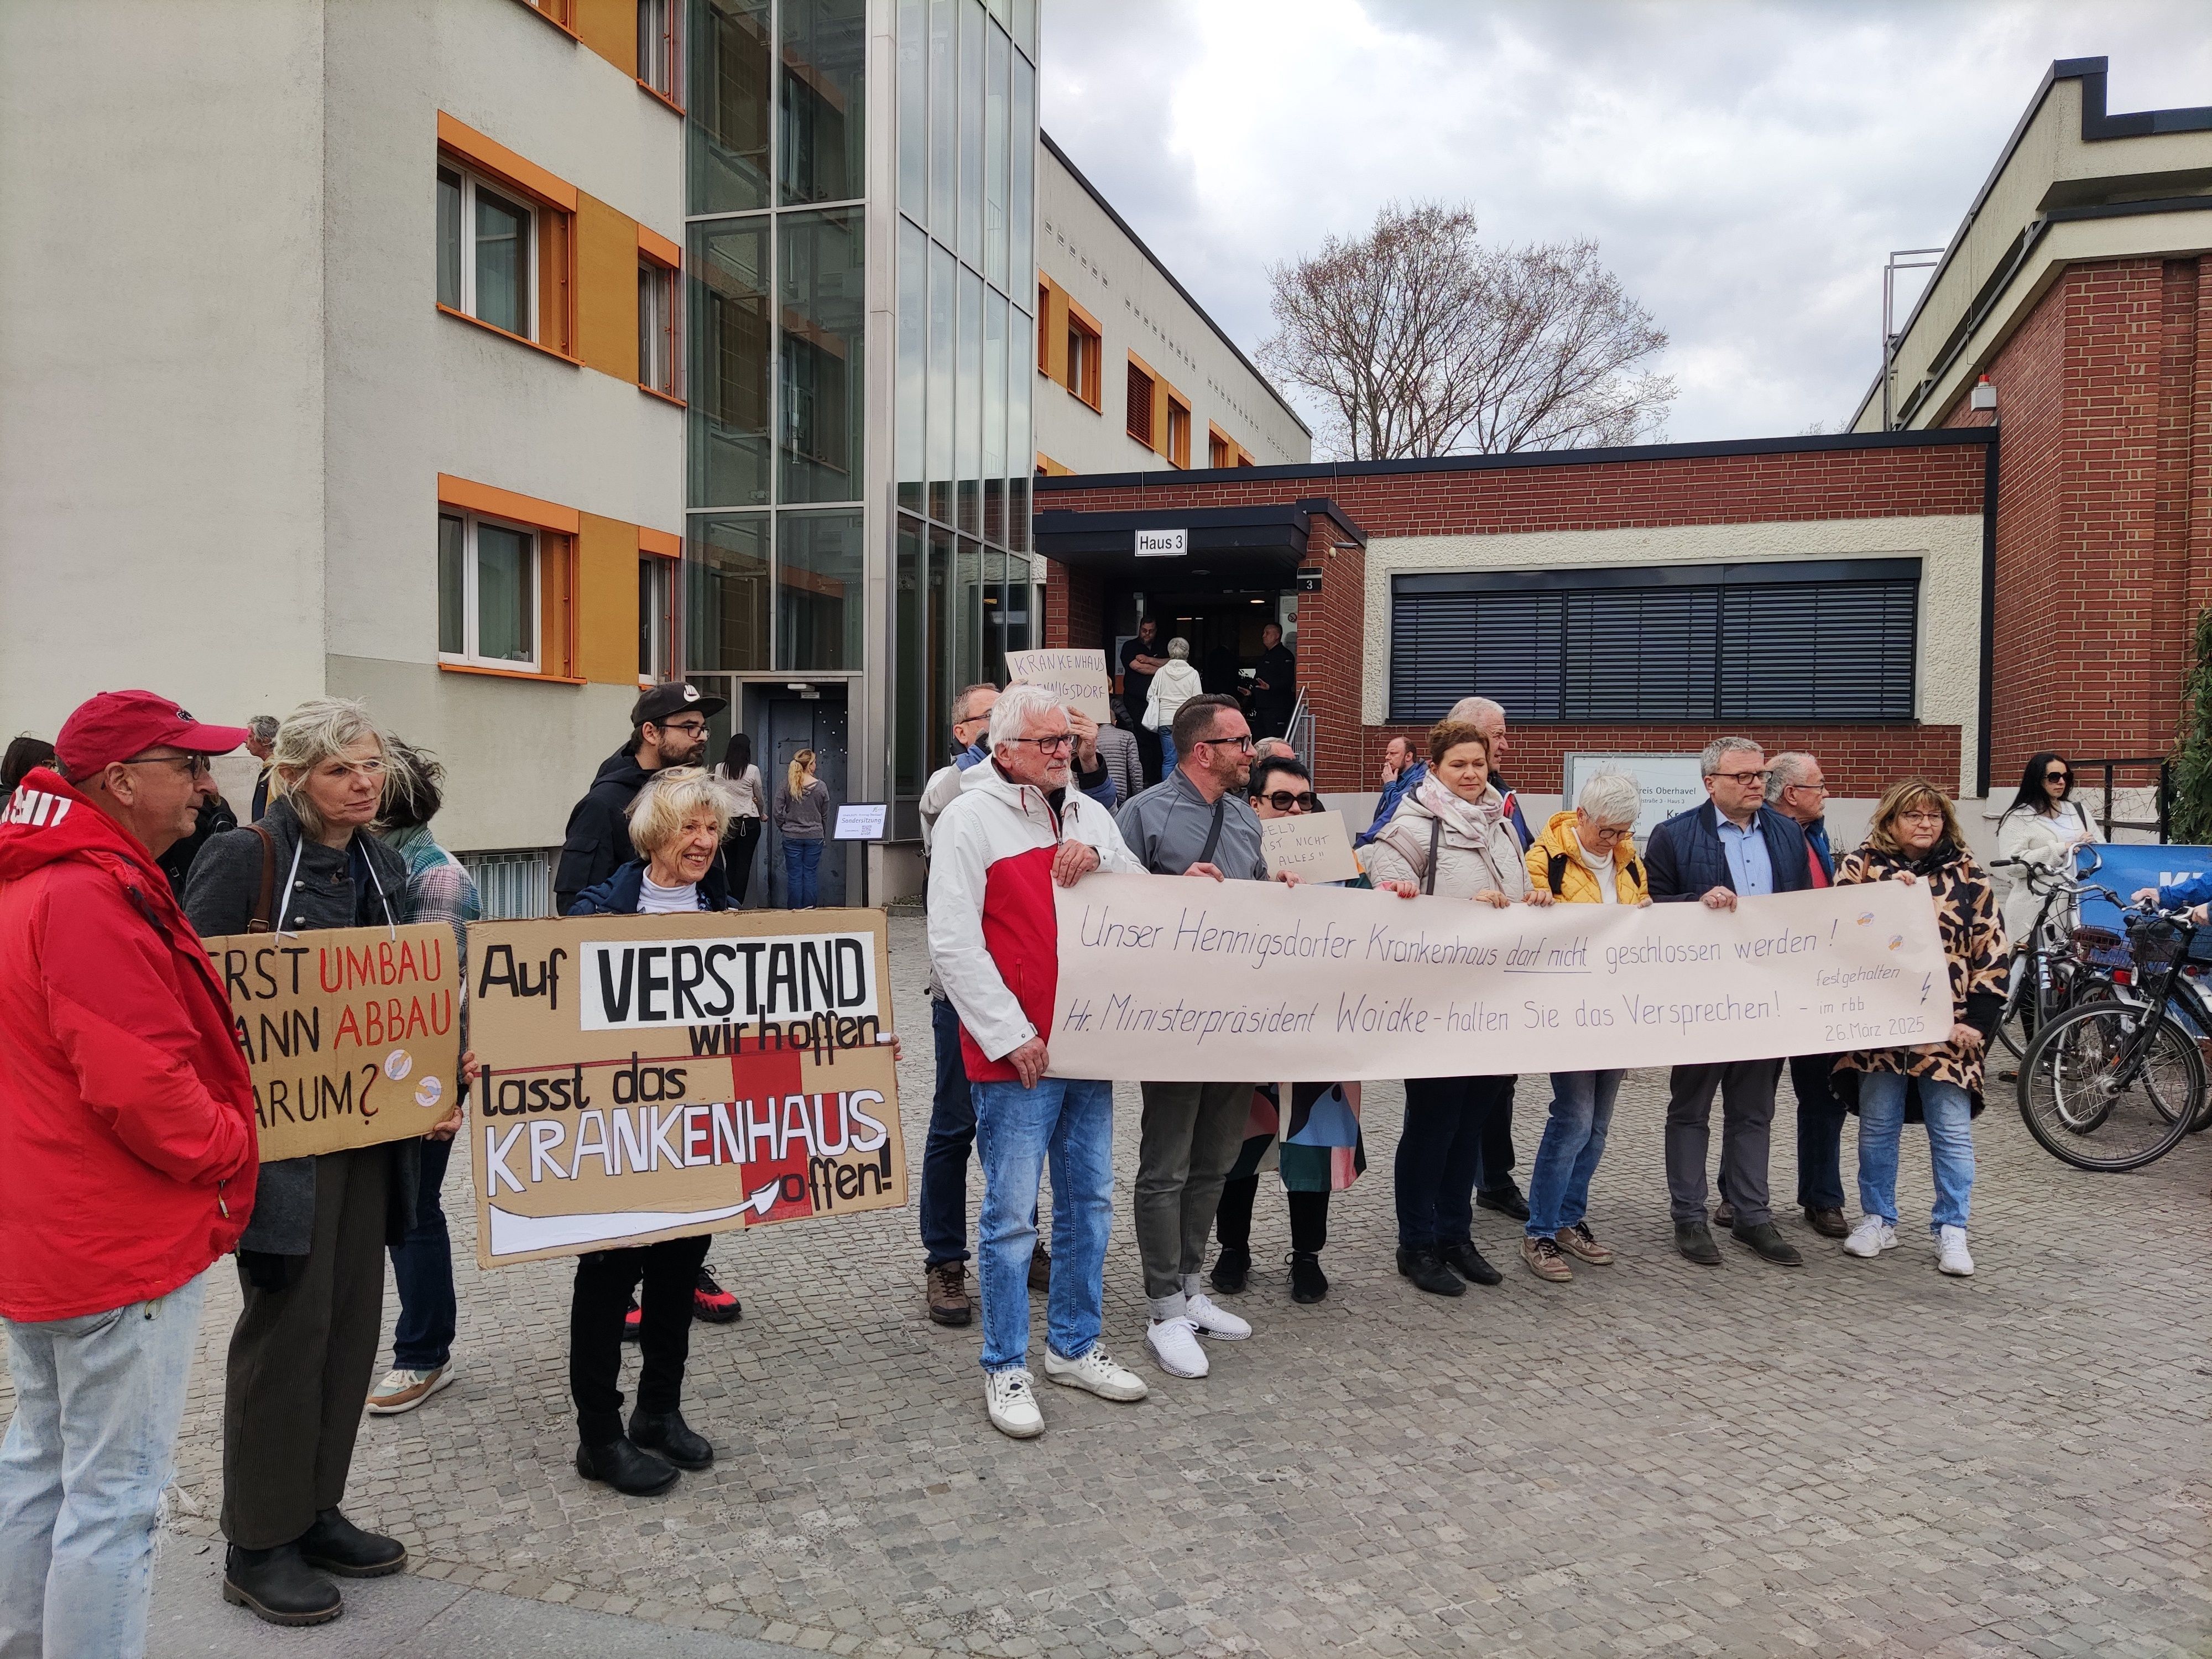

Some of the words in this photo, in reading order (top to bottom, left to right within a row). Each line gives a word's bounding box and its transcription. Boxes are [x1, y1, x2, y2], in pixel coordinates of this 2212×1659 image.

[1140, 536, 1172, 550] Haus
[1176, 535, 1182, 549] 3
[1306, 580, 1313, 589] 3
[1014, 654, 1104, 675] KRANKENHAUS
[1263, 838, 1282, 852] IST
[1296, 834, 1330, 847] NICHT
[1081, 905, 1164, 948] Unser
[1173, 907, 1357, 969] Hennigsdorfer
[1366, 924, 1498, 966] Krankenhaus
[1506, 935, 1548, 967] darf
[1548, 936, 1588, 967] nicht
[1606, 935, 1720, 974] geschlossen
[1734, 927, 1817, 959] werden
[208, 947, 310, 1003] RST
[319, 938, 442, 993] UMBAU
[478, 945, 567, 1010] Auf
[597, 938, 866, 1022] VERSTAND
[1817, 964, 1900, 988] festgehalten
[234, 1006, 320, 1065] ANN
[333, 989, 451, 1050] ABBAU
[1063, 999, 1090, 1032] Hr.
[1100, 993, 1319, 1045] Ministerpräsident
[1524, 1000, 1559, 1029] Sie
[1575, 999, 1614, 1027] das
[1623, 990, 1780, 1036] Versprechen!
[1819, 1000, 1833, 1015] im
[1841, 997, 1864, 1012] rbb
[1890, 1016, 1924, 1036] 2025
[688, 1017, 749, 1057] wir
[252, 1063, 380, 1129] ARUM?
[481, 1063, 590, 1117] lasst
[613, 1051, 687, 1104] das
[485, 1089, 888, 1198] KRANKENHAUS
[780, 1137, 893, 1212] offen!
